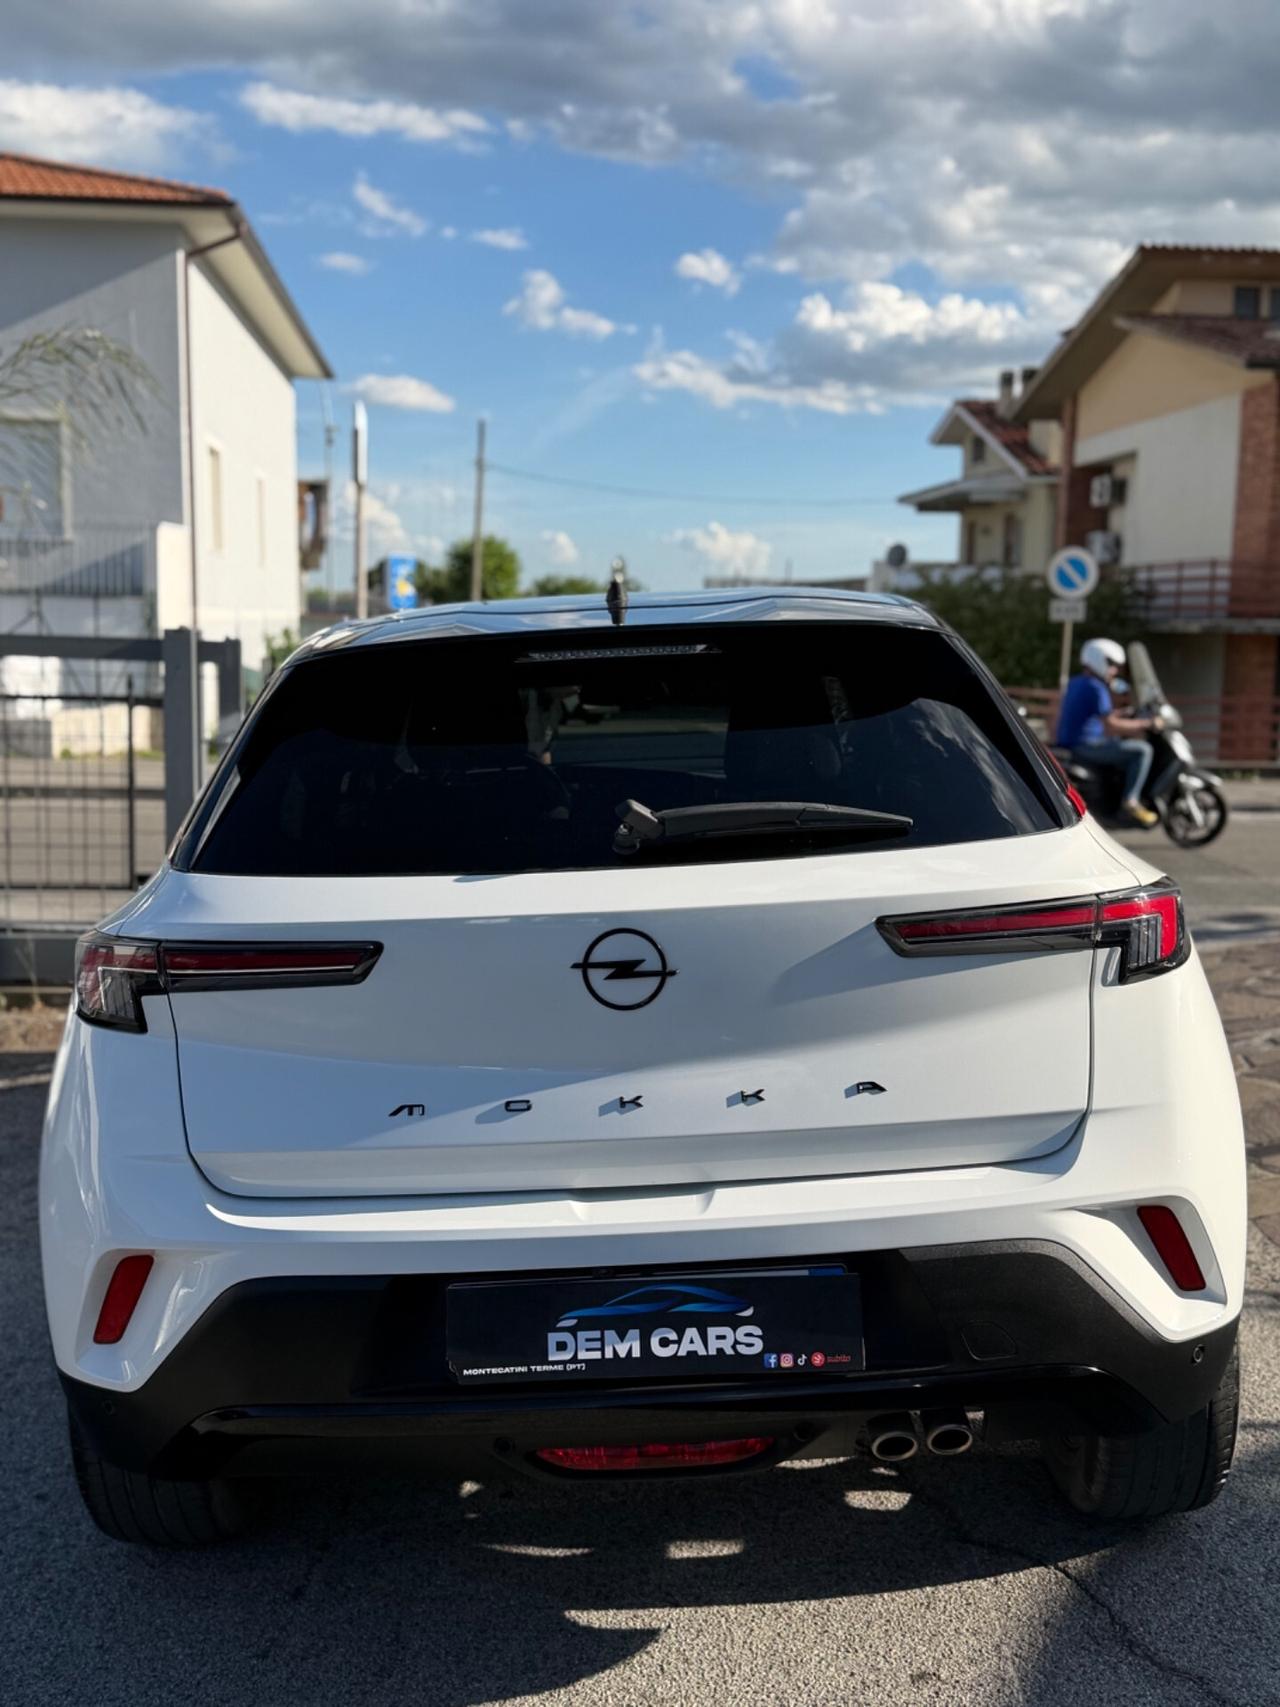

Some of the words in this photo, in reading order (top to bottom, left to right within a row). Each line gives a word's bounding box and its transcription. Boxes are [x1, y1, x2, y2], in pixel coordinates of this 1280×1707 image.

[547, 1329, 640, 1361] DEM
[650, 1325, 763, 1357] CARS
[463, 1366, 528, 1376] MONTECATINI
[530, 1364, 564, 1372] TERME
